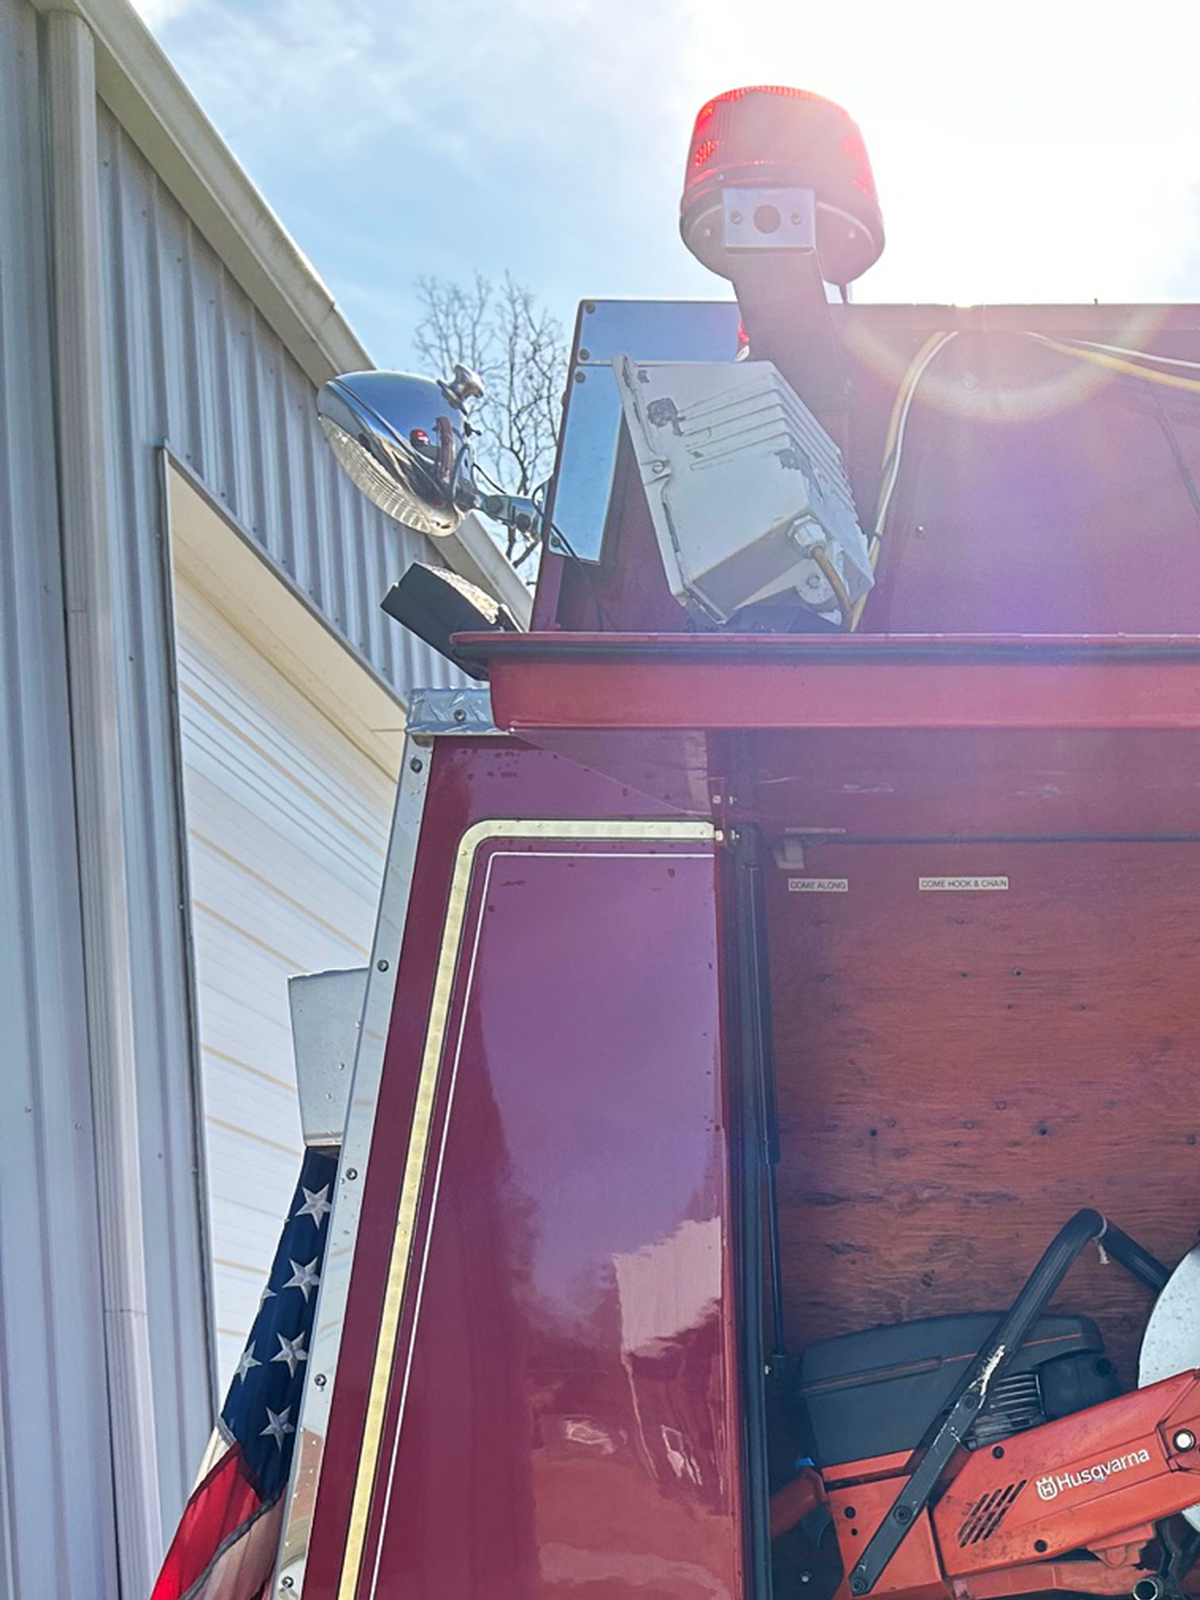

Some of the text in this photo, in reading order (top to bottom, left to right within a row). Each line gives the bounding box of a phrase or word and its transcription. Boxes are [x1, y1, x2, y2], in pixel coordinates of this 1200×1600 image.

[790, 880, 846, 889] COME ALONG
[921, 880, 946, 888] COME
[981, 879, 1007, 887] CHAIN
[1056, 1449, 1150, 1492] Husqvarna
